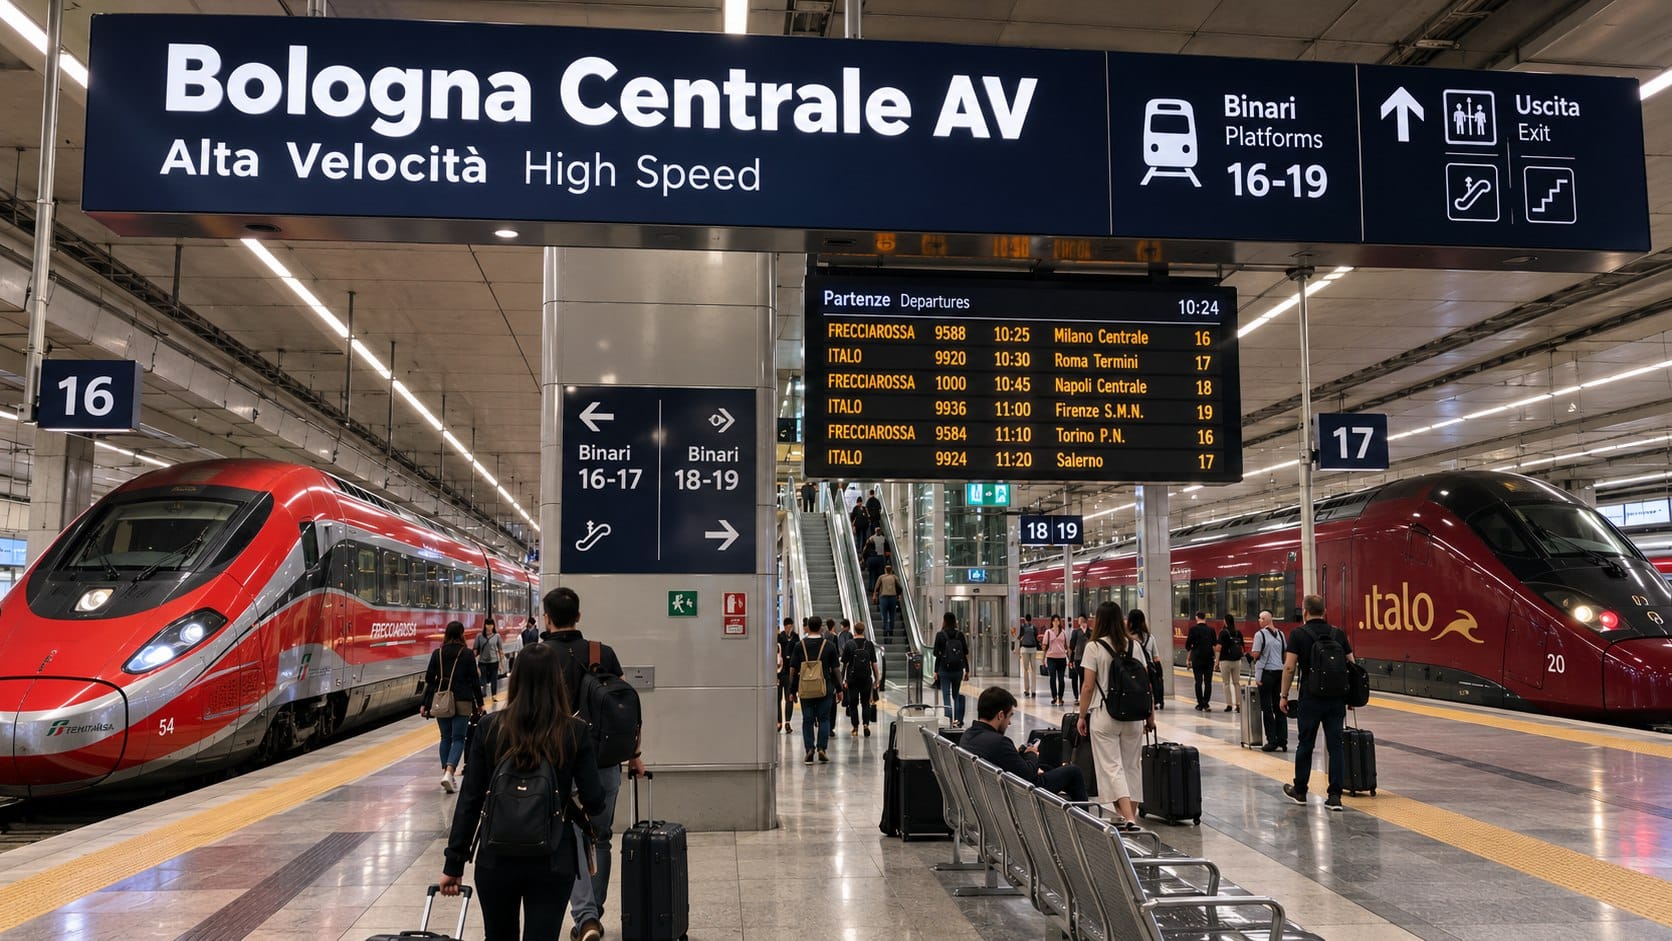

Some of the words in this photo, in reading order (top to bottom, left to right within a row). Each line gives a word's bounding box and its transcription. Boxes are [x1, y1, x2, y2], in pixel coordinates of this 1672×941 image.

[166, 44, 531, 137] Bologna
[560, 57, 911, 136] Centrale
[933, 75, 1038, 139] AV
[1225, 94, 1295, 119] Binari
[1515, 94, 1580, 117] Uscita
[1225, 125, 1323, 149] Platforms
[1518, 122, 1551, 142] Exit
[160, 139, 258, 176] Alta
[287, 142, 486, 183] Velocità
[526, 151, 615, 194] High
[637, 155, 759, 196] Speed
[1228, 163, 1327, 198] 16-19
[824, 289, 891, 307] Partenze
[900, 293, 970, 311] Departures
[1178, 299, 1220, 315] 10:24
[828, 322, 916, 340] FRECCIAROSSA
[934, 325, 966, 341] 9588
[994, 326, 1030, 342] 10:25
[1054, 327, 1094, 344] Milano
[1098, 328, 1149, 345] Centrale
[1194, 330, 1211, 346] 16
[828, 347, 862, 364] ITALO
[935, 350, 967, 366] 9920
[994, 351, 1031, 367] 10:30
[1054, 352, 1089, 368] Roma
[1093, 353, 1138, 369] Termini
[1195, 355, 1211, 371] 17
[59, 376, 113, 416] 16
[828, 373, 916, 390] FRECCIAROSSA
[935, 375, 967, 391] 1000
[994, 375, 1031, 392] 10:45
[1055, 377, 1092, 396] Napoli
[1096, 378, 1147, 394] Centrale
[1196, 379, 1212, 396] 18
[828, 398, 863, 414] ITALO
[935, 400, 967, 416] 9936
[994, 401, 1031, 417] 11:00
[1055, 402, 1100, 418] Firenze
[1104, 403, 1144, 419] S.M.N.
[1196, 404, 1213, 420] 19
[828, 424, 916, 440] FRECCIAROSSA
[935, 425, 967, 441] 9584
[995, 426, 1032, 442] 11:10
[1055, 427, 1095, 443] Torino
[1099, 427, 1126, 444] P.N.
[1197, 429, 1214, 445] 16
[1333, 427, 1373, 458] 17
[579, 444, 631, 461] Binari
[688, 445, 739, 463] Binari
[828, 449, 863, 465] ITALO
[935, 451, 968, 466] 9924
[995, 451, 1032, 467] 11:20
[1056, 452, 1104, 468] Salerno
[1198, 453, 1215, 470] 17
[578, 468, 643, 490] 16-17
[674, 469, 739, 491] 18-19
[1027, 521, 1049, 540] 18
[1057, 522, 1078, 540] 19
[1547, 653, 1565, 674] 20
[158, 717, 175, 737] 54
